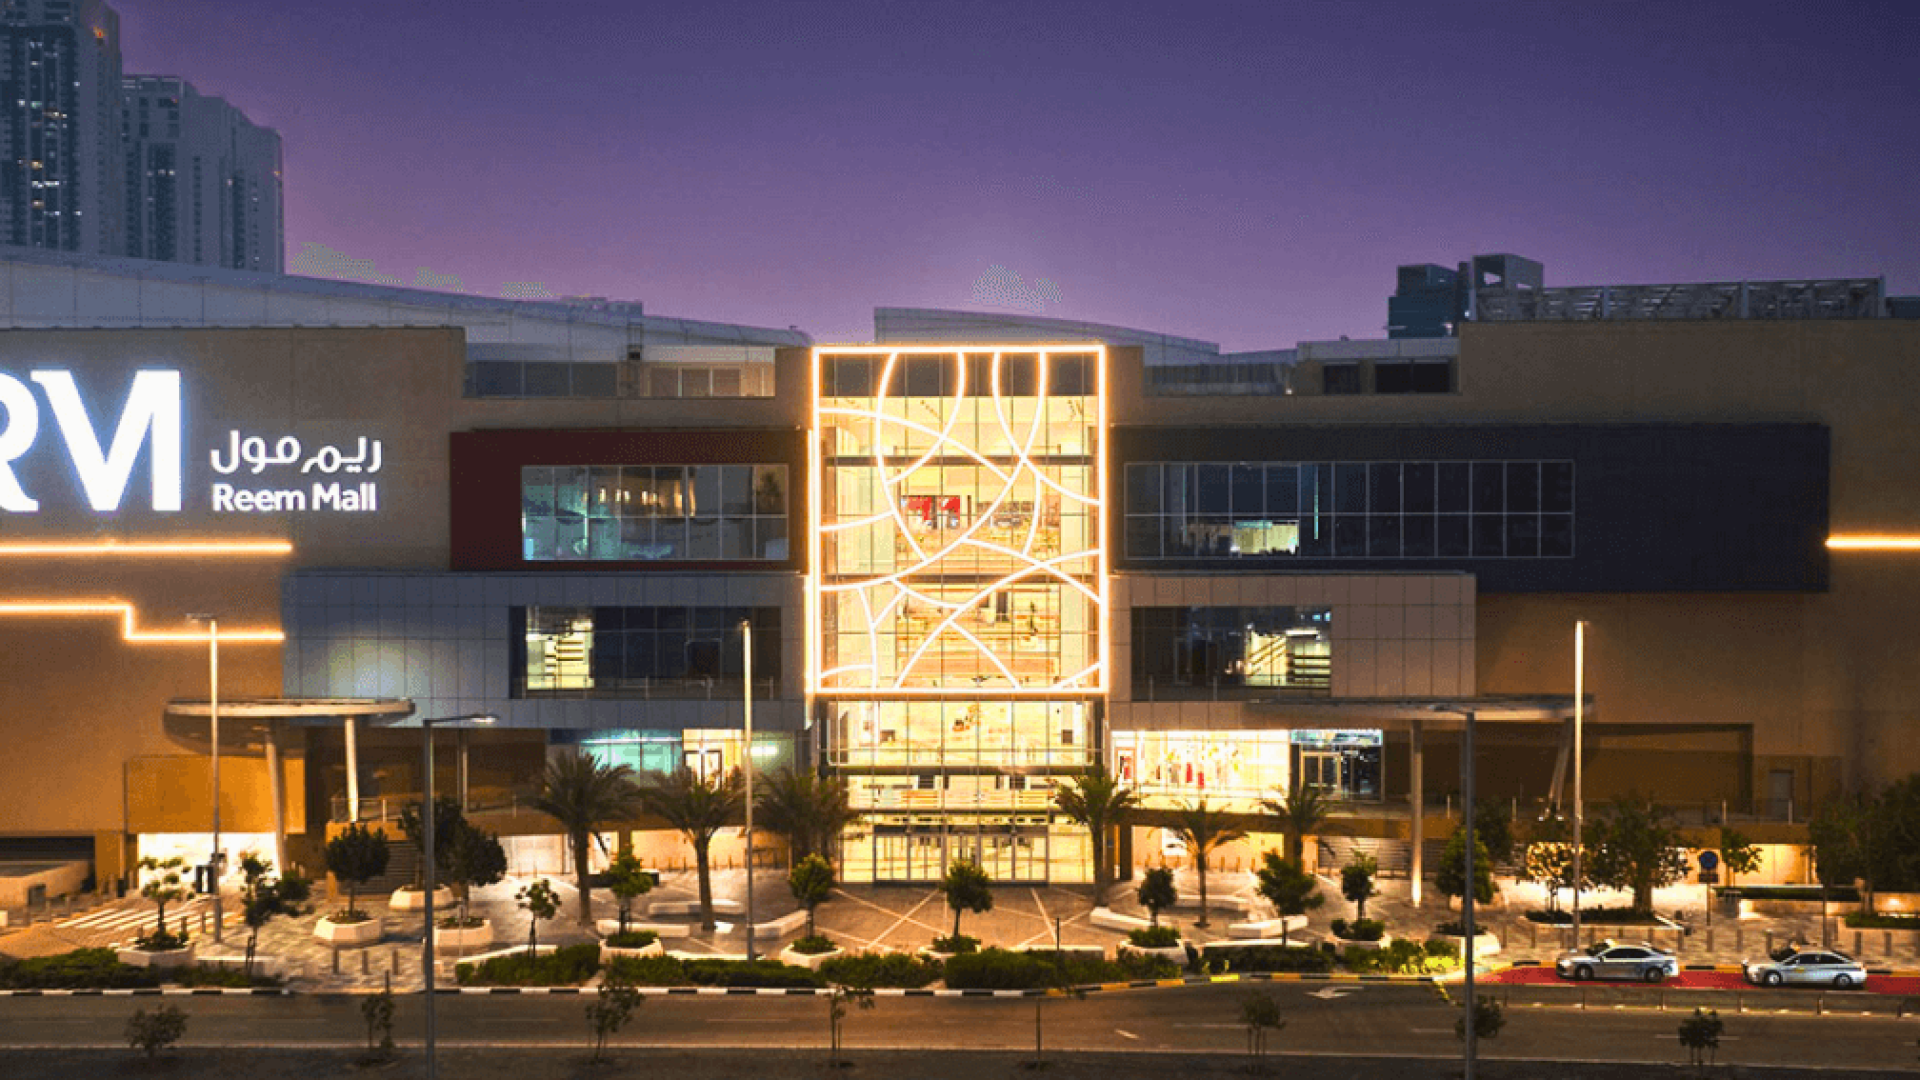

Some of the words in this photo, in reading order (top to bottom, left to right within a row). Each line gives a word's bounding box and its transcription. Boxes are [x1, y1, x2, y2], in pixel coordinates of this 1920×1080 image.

[211, 430, 300, 473] مول
[302, 436, 382, 473] ريم
[212, 483, 306, 512] Reem
[312, 483, 376, 512] Mall
